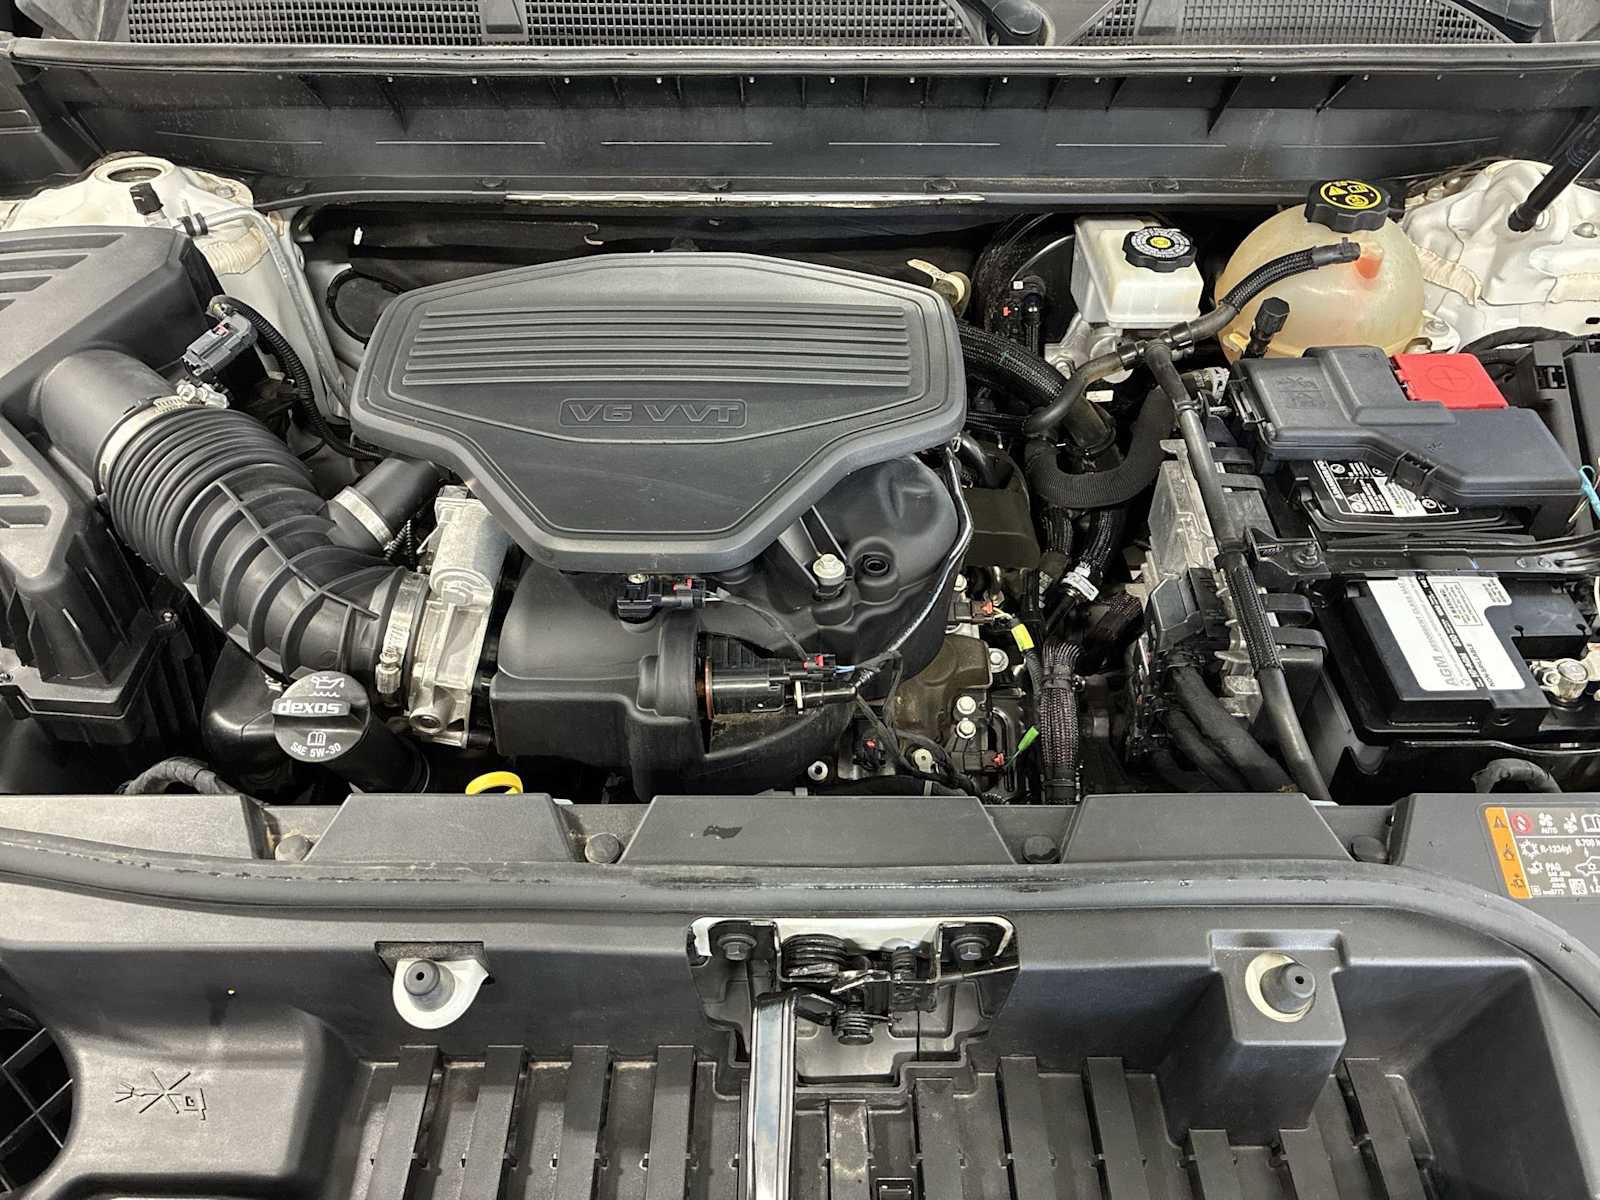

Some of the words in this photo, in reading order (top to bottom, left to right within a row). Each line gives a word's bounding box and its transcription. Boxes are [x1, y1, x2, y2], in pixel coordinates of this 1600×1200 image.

[568, 403, 632, 422] V6
[643, 403, 739, 423] VVT
[1430, 656, 1460, 687] AGM
[278, 700, 342, 714] dexos
[290, 742, 308, 757] SAE
[310, 743, 341, 757] 5W-30
